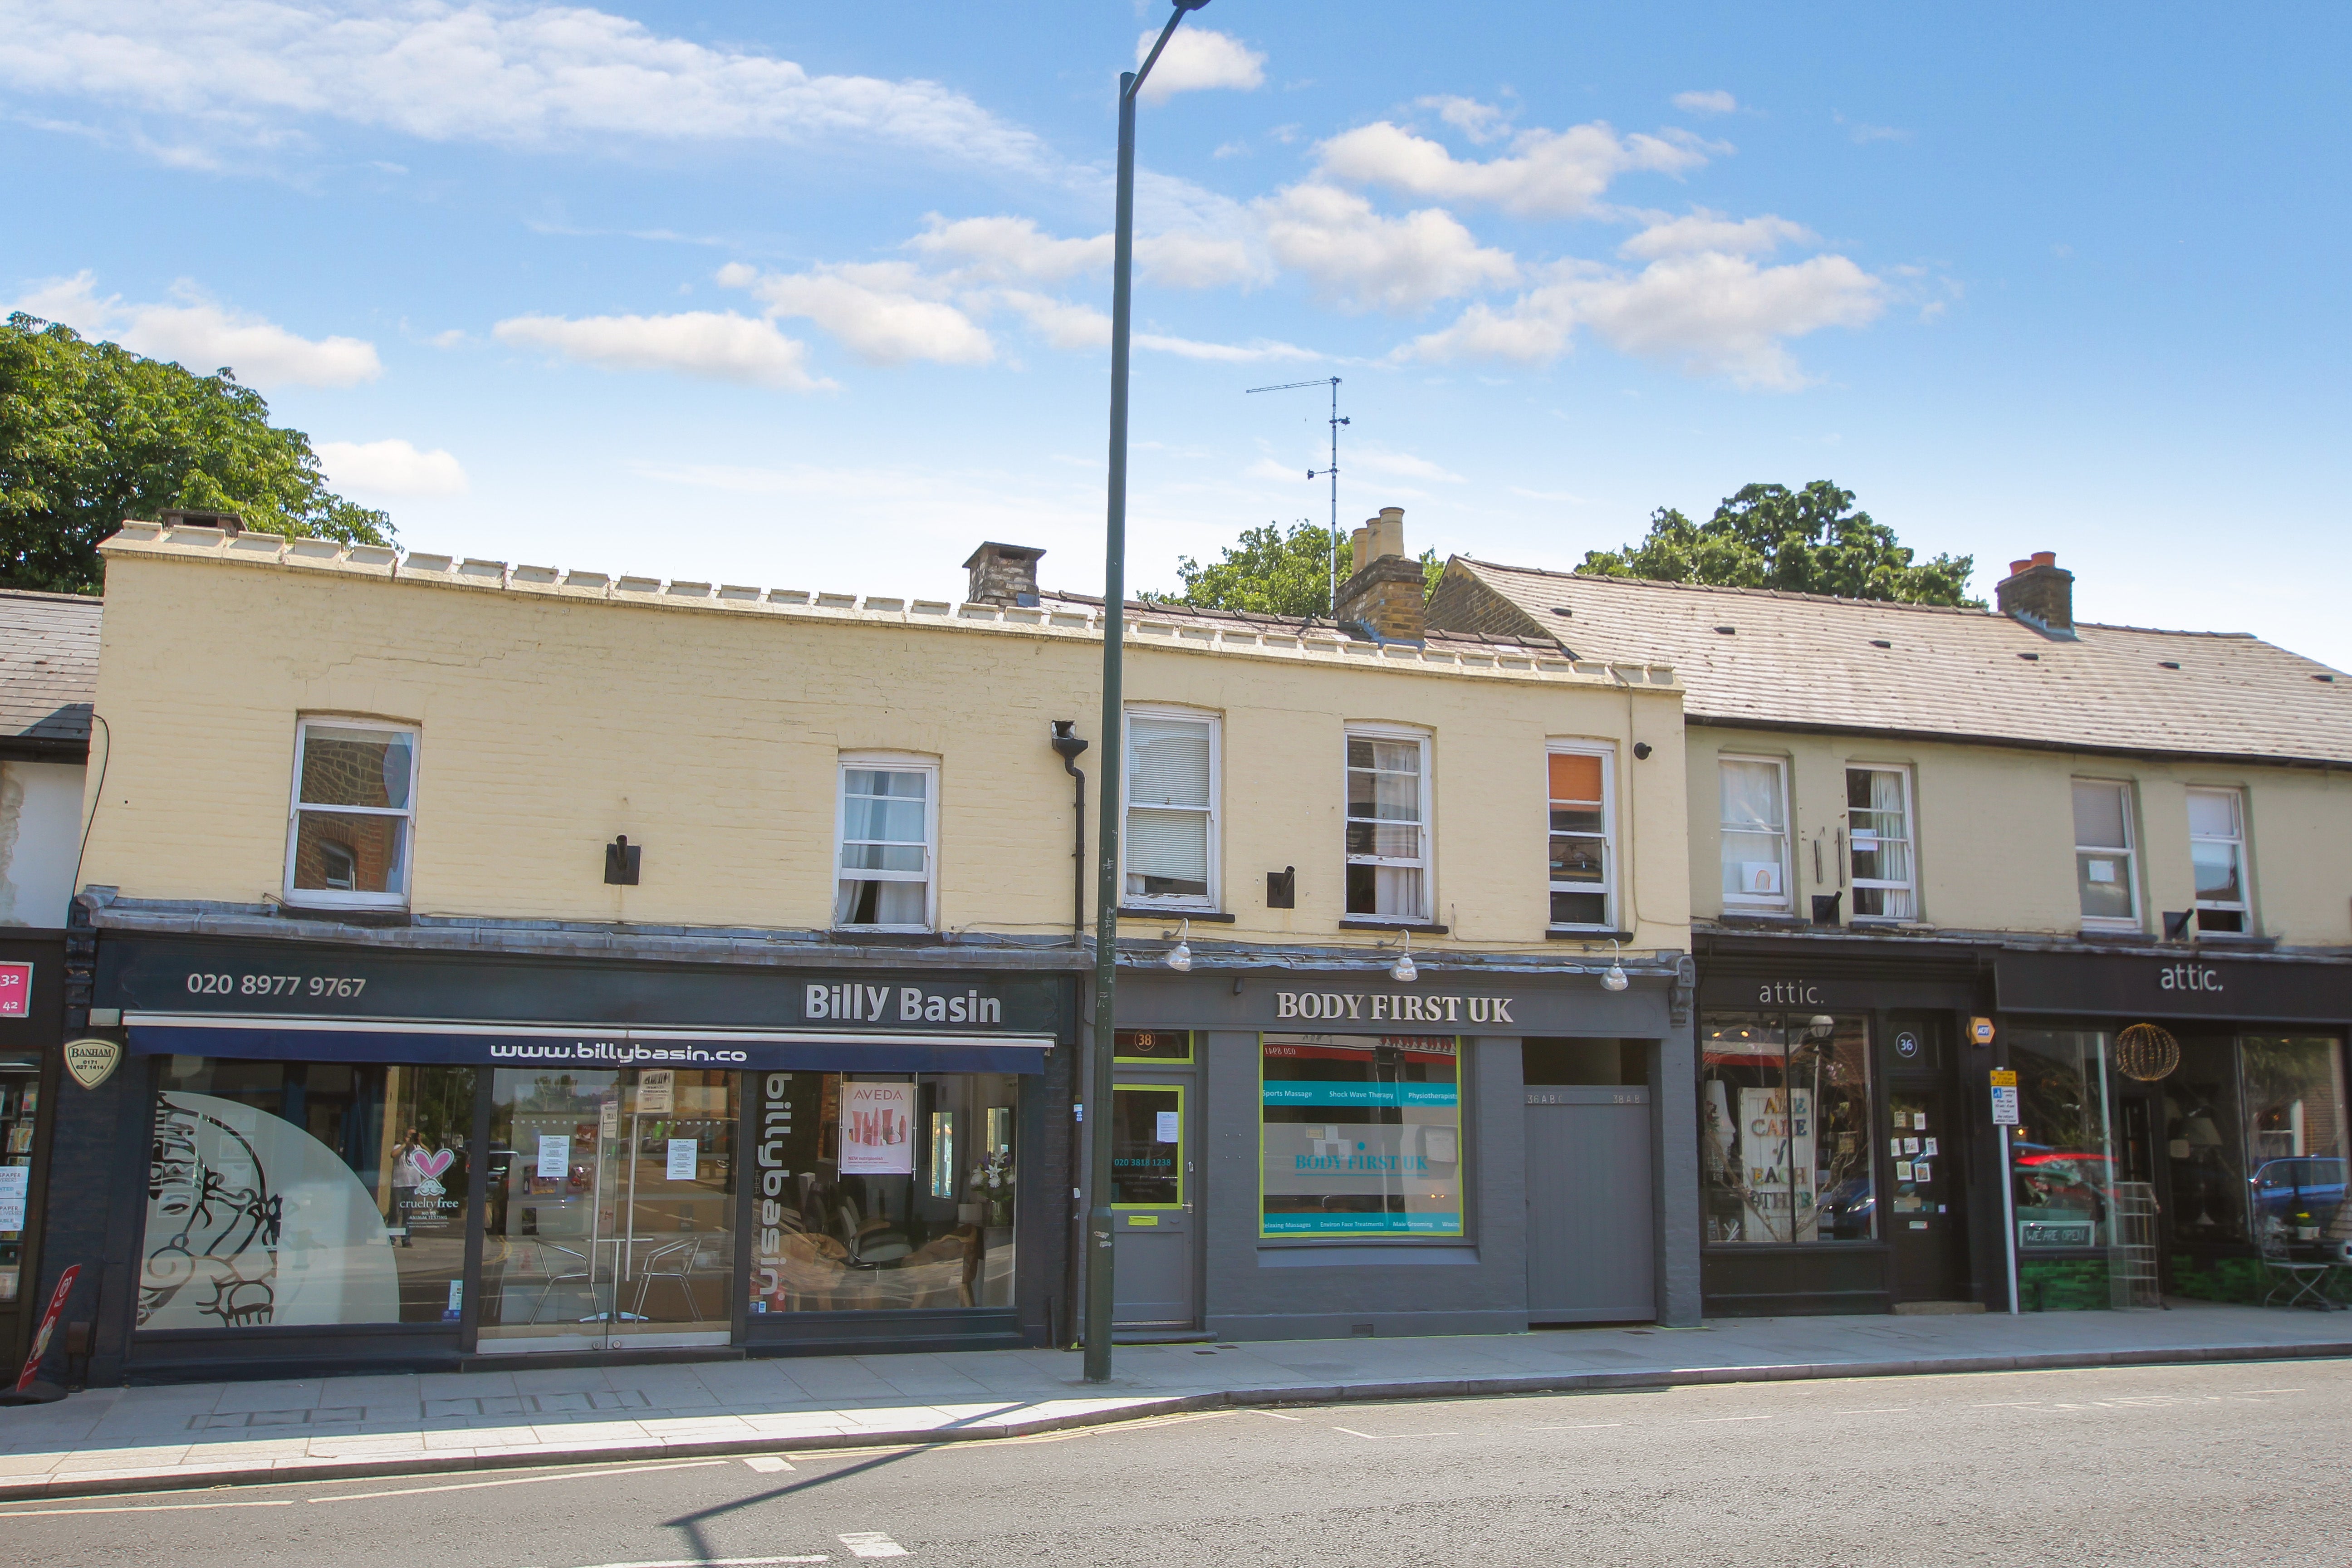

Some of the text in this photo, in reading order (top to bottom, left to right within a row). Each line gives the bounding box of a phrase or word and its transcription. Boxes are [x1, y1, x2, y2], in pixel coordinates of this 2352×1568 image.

[187, 973, 367, 997] 020 8977 9767
[2161, 963, 2224, 991] attic.
[1759, 979, 1824, 1004] attic.
[3, 1001, 18, 1011] 42
[806, 983, 1001, 1023] Billy Basin
[1276, 992, 1514, 1023] BODY FIRST UK
[1139, 1034, 1152, 1046] 38
[1901, 1039, 1913, 1051] 36
[71, 1048, 112, 1057] BANHAM
[490, 1042, 747, 1063] www.billybasin.co
[854, 1089, 903, 1100] AVEDA
[1764, 1097, 1807, 1114] AE
[1295, 1155, 1428, 1171] BODY FIRST UK
[758, 1073, 793, 1294] billybasin
[400, 1197, 459, 1210] cruelty free
